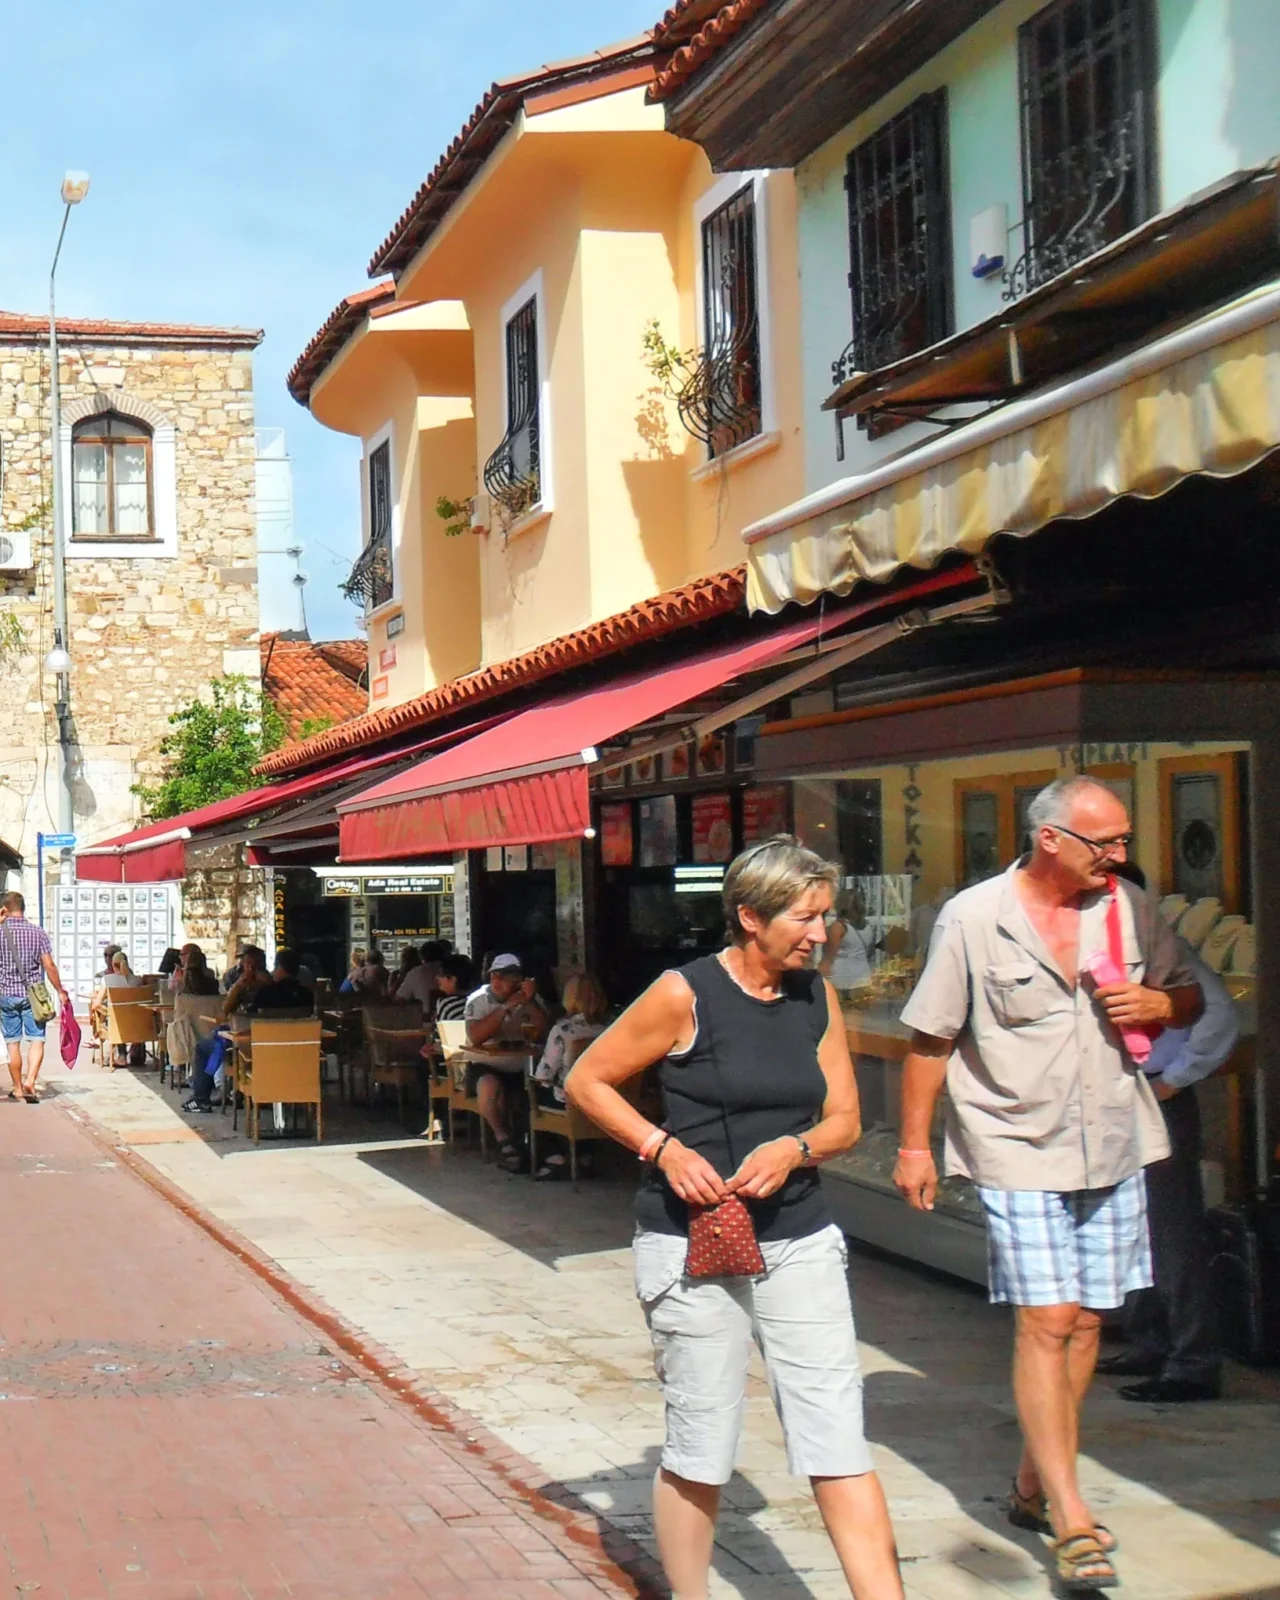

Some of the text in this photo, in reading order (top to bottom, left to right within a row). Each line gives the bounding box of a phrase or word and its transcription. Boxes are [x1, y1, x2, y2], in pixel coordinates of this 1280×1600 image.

[367, 878, 440, 887] Ada Real Estate
